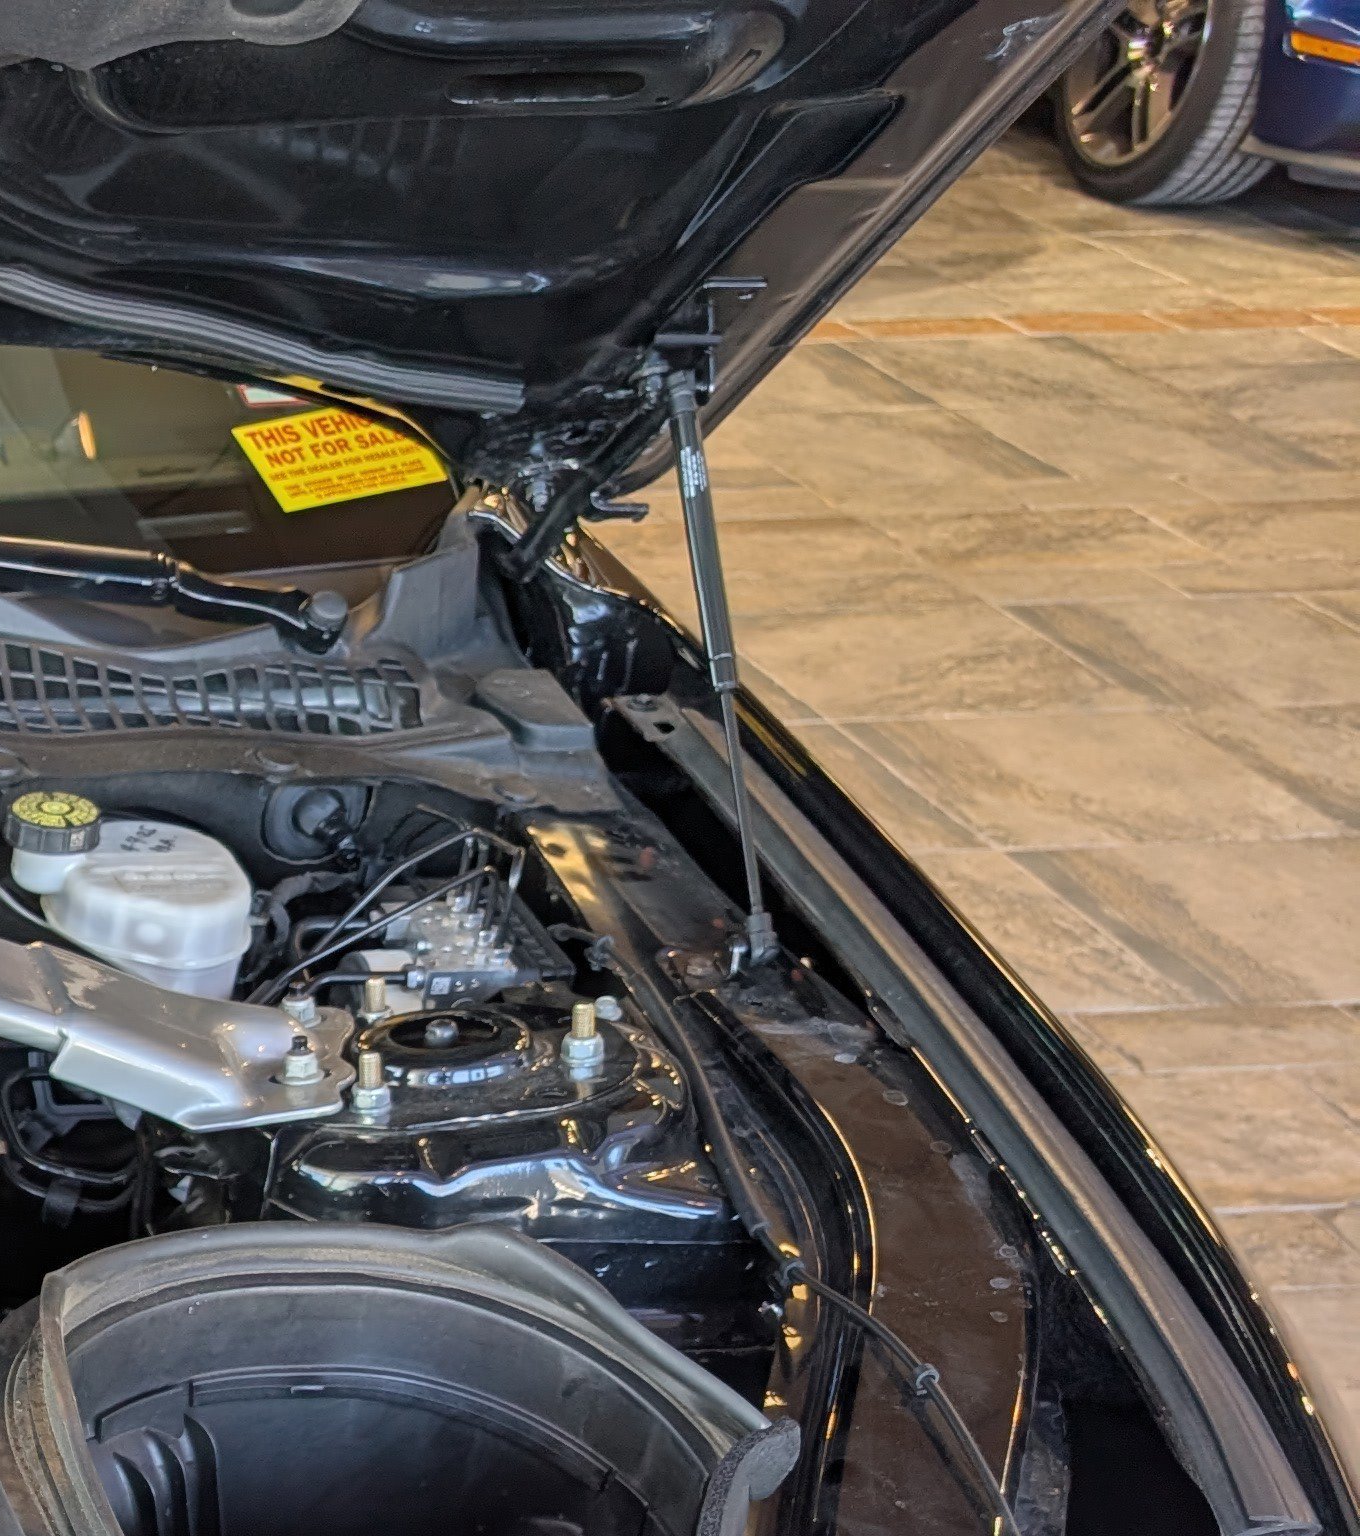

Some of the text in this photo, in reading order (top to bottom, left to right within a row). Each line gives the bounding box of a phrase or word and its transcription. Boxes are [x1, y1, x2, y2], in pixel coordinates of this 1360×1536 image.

[244, 411, 374, 452] THIS VEHIC
[265, 446, 307, 469] NOT
[310, 438, 353, 459] FOR
